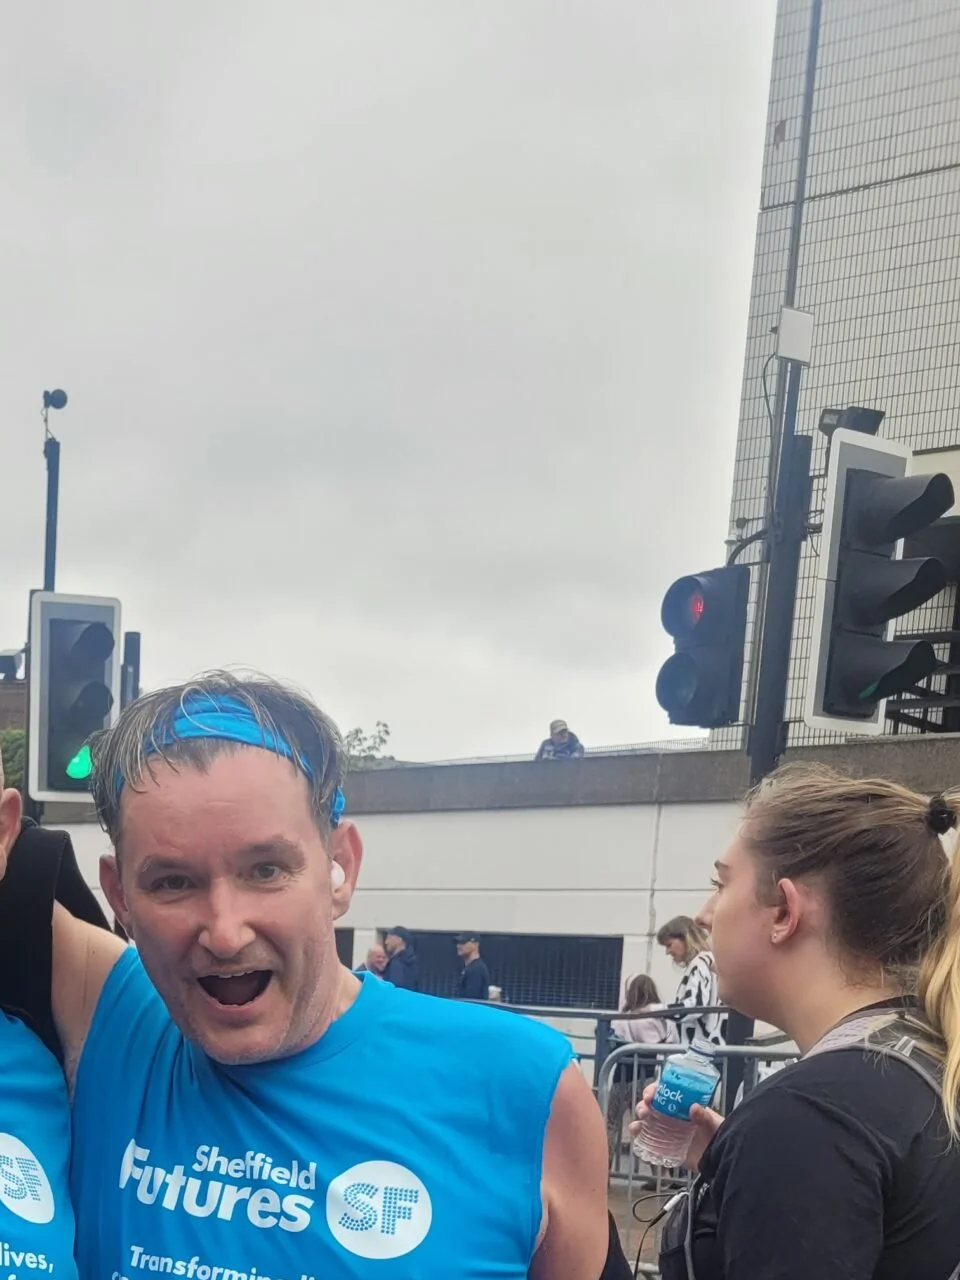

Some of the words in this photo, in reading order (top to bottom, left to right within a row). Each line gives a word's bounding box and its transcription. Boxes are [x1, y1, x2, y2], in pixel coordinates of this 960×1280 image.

[118, 1137, 315, 1233] Futures
[192, 1144, 318, 1191] Sheffield
[338, 1181, 420, 1235] SF
